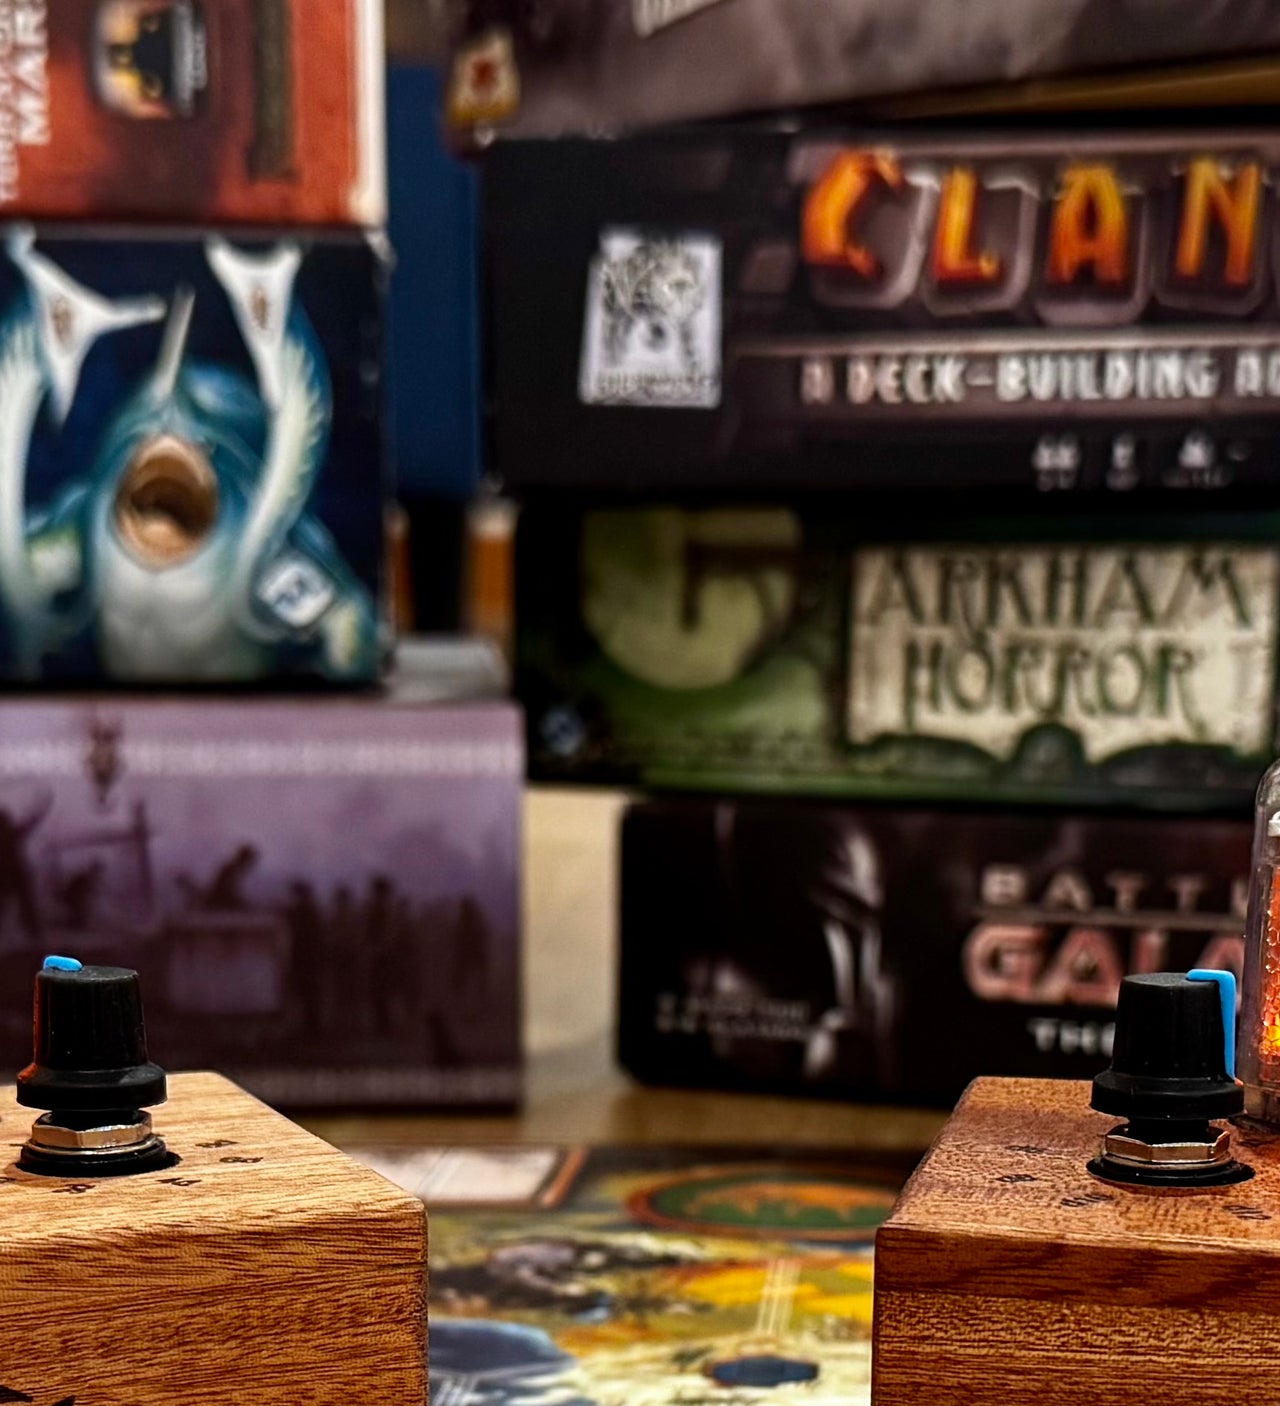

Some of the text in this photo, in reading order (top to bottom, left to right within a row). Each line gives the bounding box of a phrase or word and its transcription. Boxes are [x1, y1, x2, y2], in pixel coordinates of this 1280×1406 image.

[846, 350, 1216, 402] DECK-BUILDING
[867, 546, 1253, 634] ARKHAM
[902, 636, 1212, 738] HORROR
